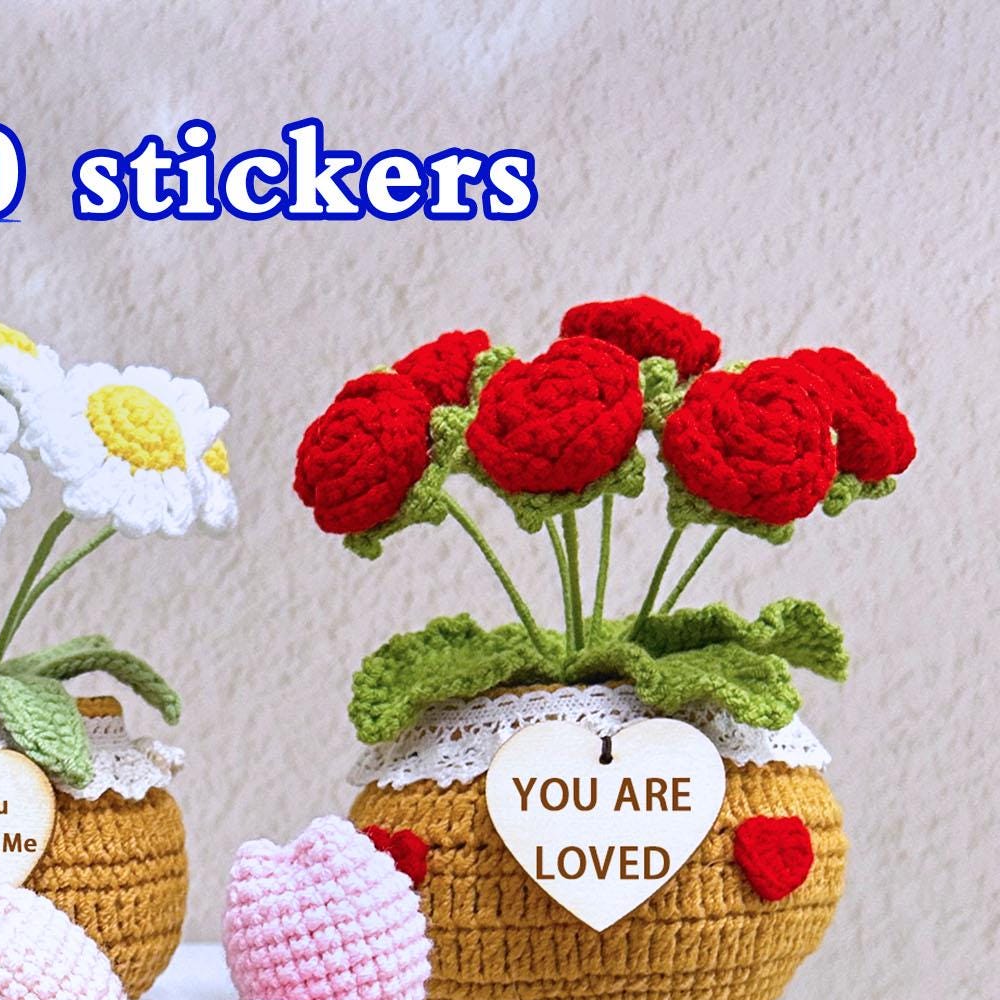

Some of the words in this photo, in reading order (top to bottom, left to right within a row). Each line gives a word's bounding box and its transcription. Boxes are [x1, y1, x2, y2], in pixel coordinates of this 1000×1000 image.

[512, 777, 598, 811] YOU
[613, 777, 692, 811] ARE
[2, 833, 37, 853] Me
[536, 846, 671, 880] LOVED
